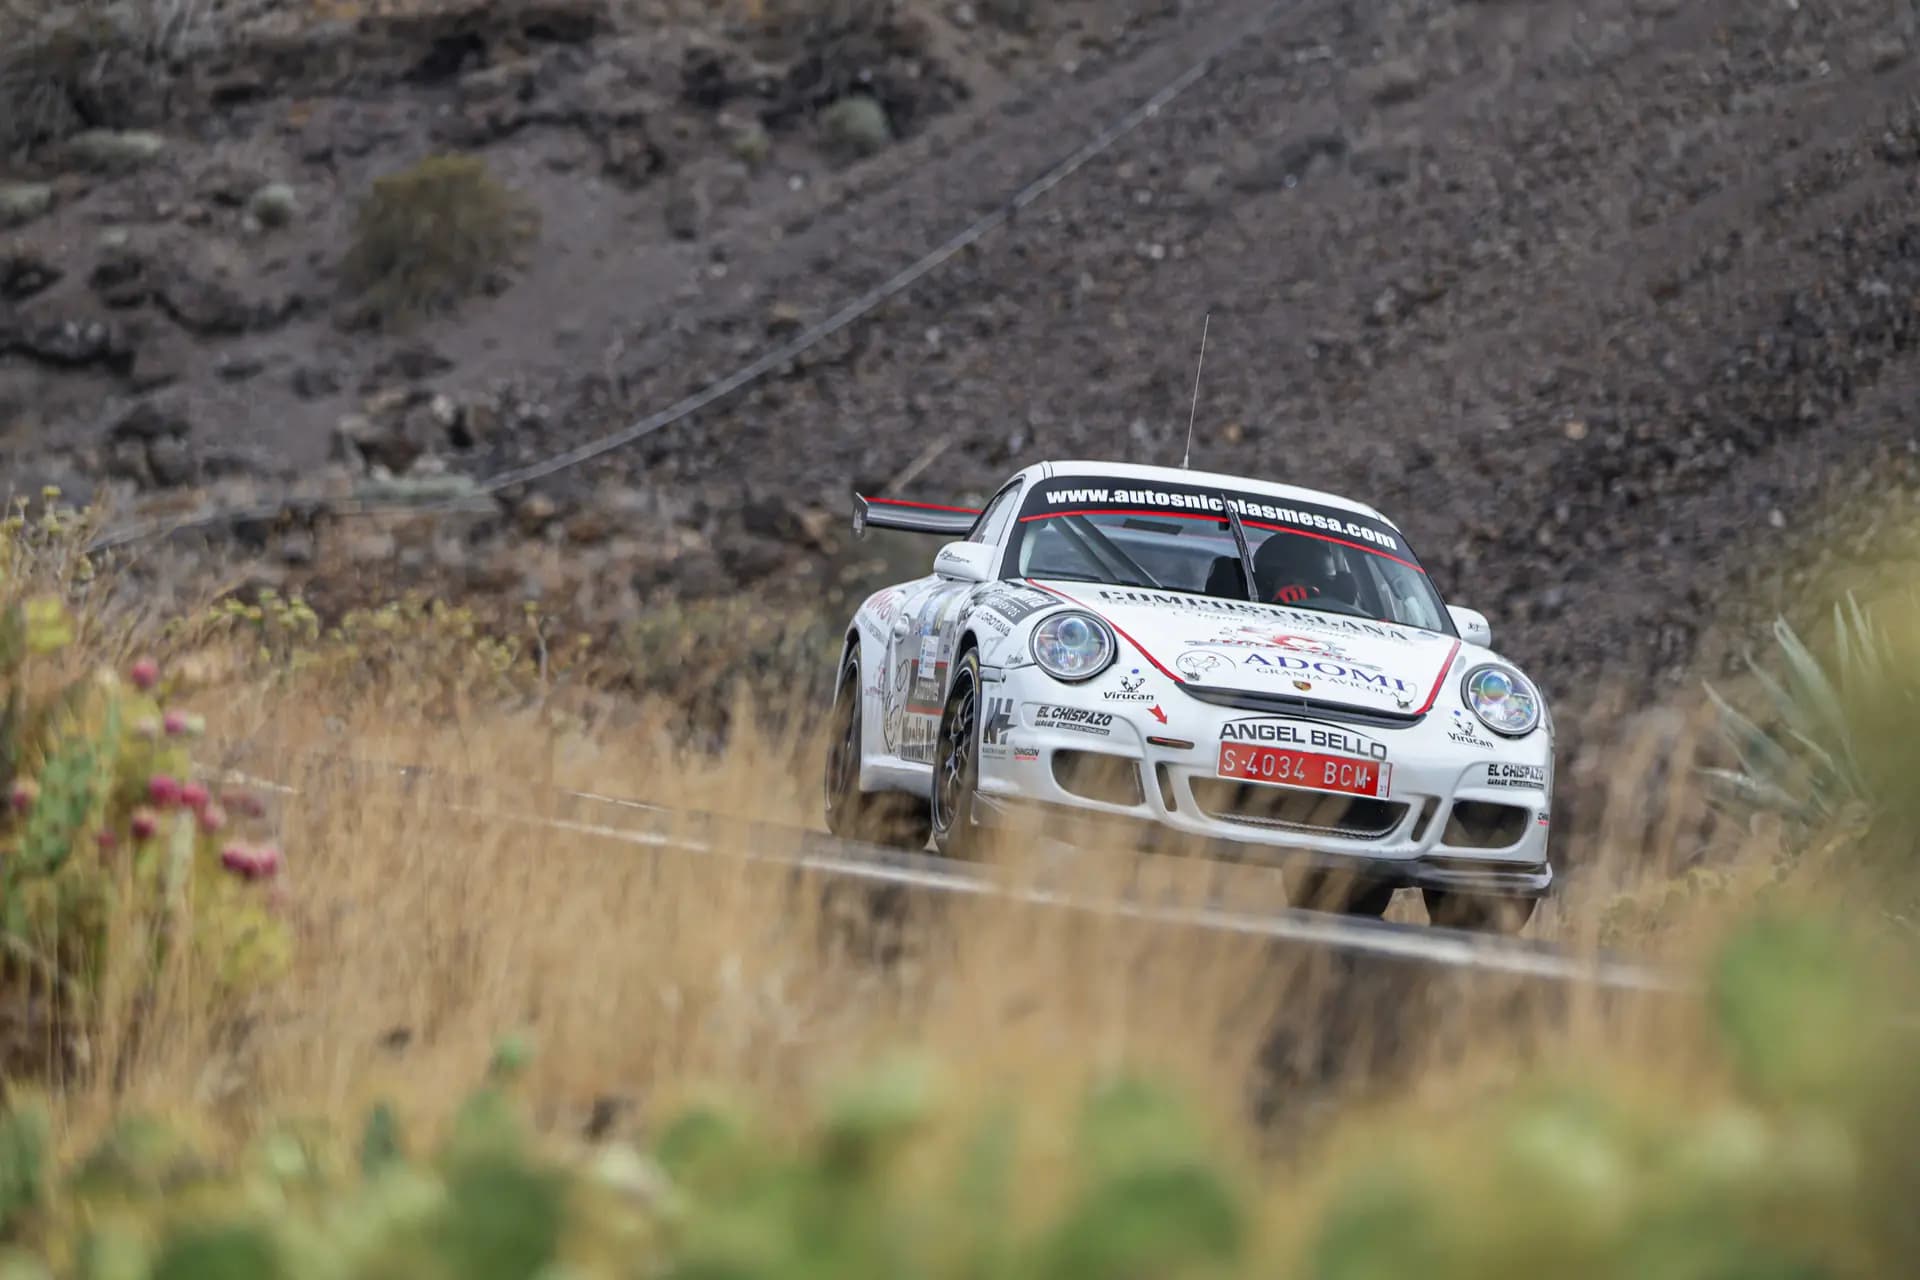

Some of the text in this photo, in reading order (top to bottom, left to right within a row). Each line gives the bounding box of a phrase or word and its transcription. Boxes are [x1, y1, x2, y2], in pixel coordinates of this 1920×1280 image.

[1244, 653, 1406, 692] ADOMI
[1256, 668, 1324, 682] GRANJA
[1103, 691, 1155, 701] Virucan
[1036, 705, 1113, 727] EL CHISPAZO
[1219, 723, 1388, 761] ANGEL BELLO
[1447, 731, 1495, 749] Virucan
[1246, 751, 1305, 781] 4034
[1323, 761, 1368, 789] BCM
[1487, 763, 1544, 781] EL CHISPAZO
